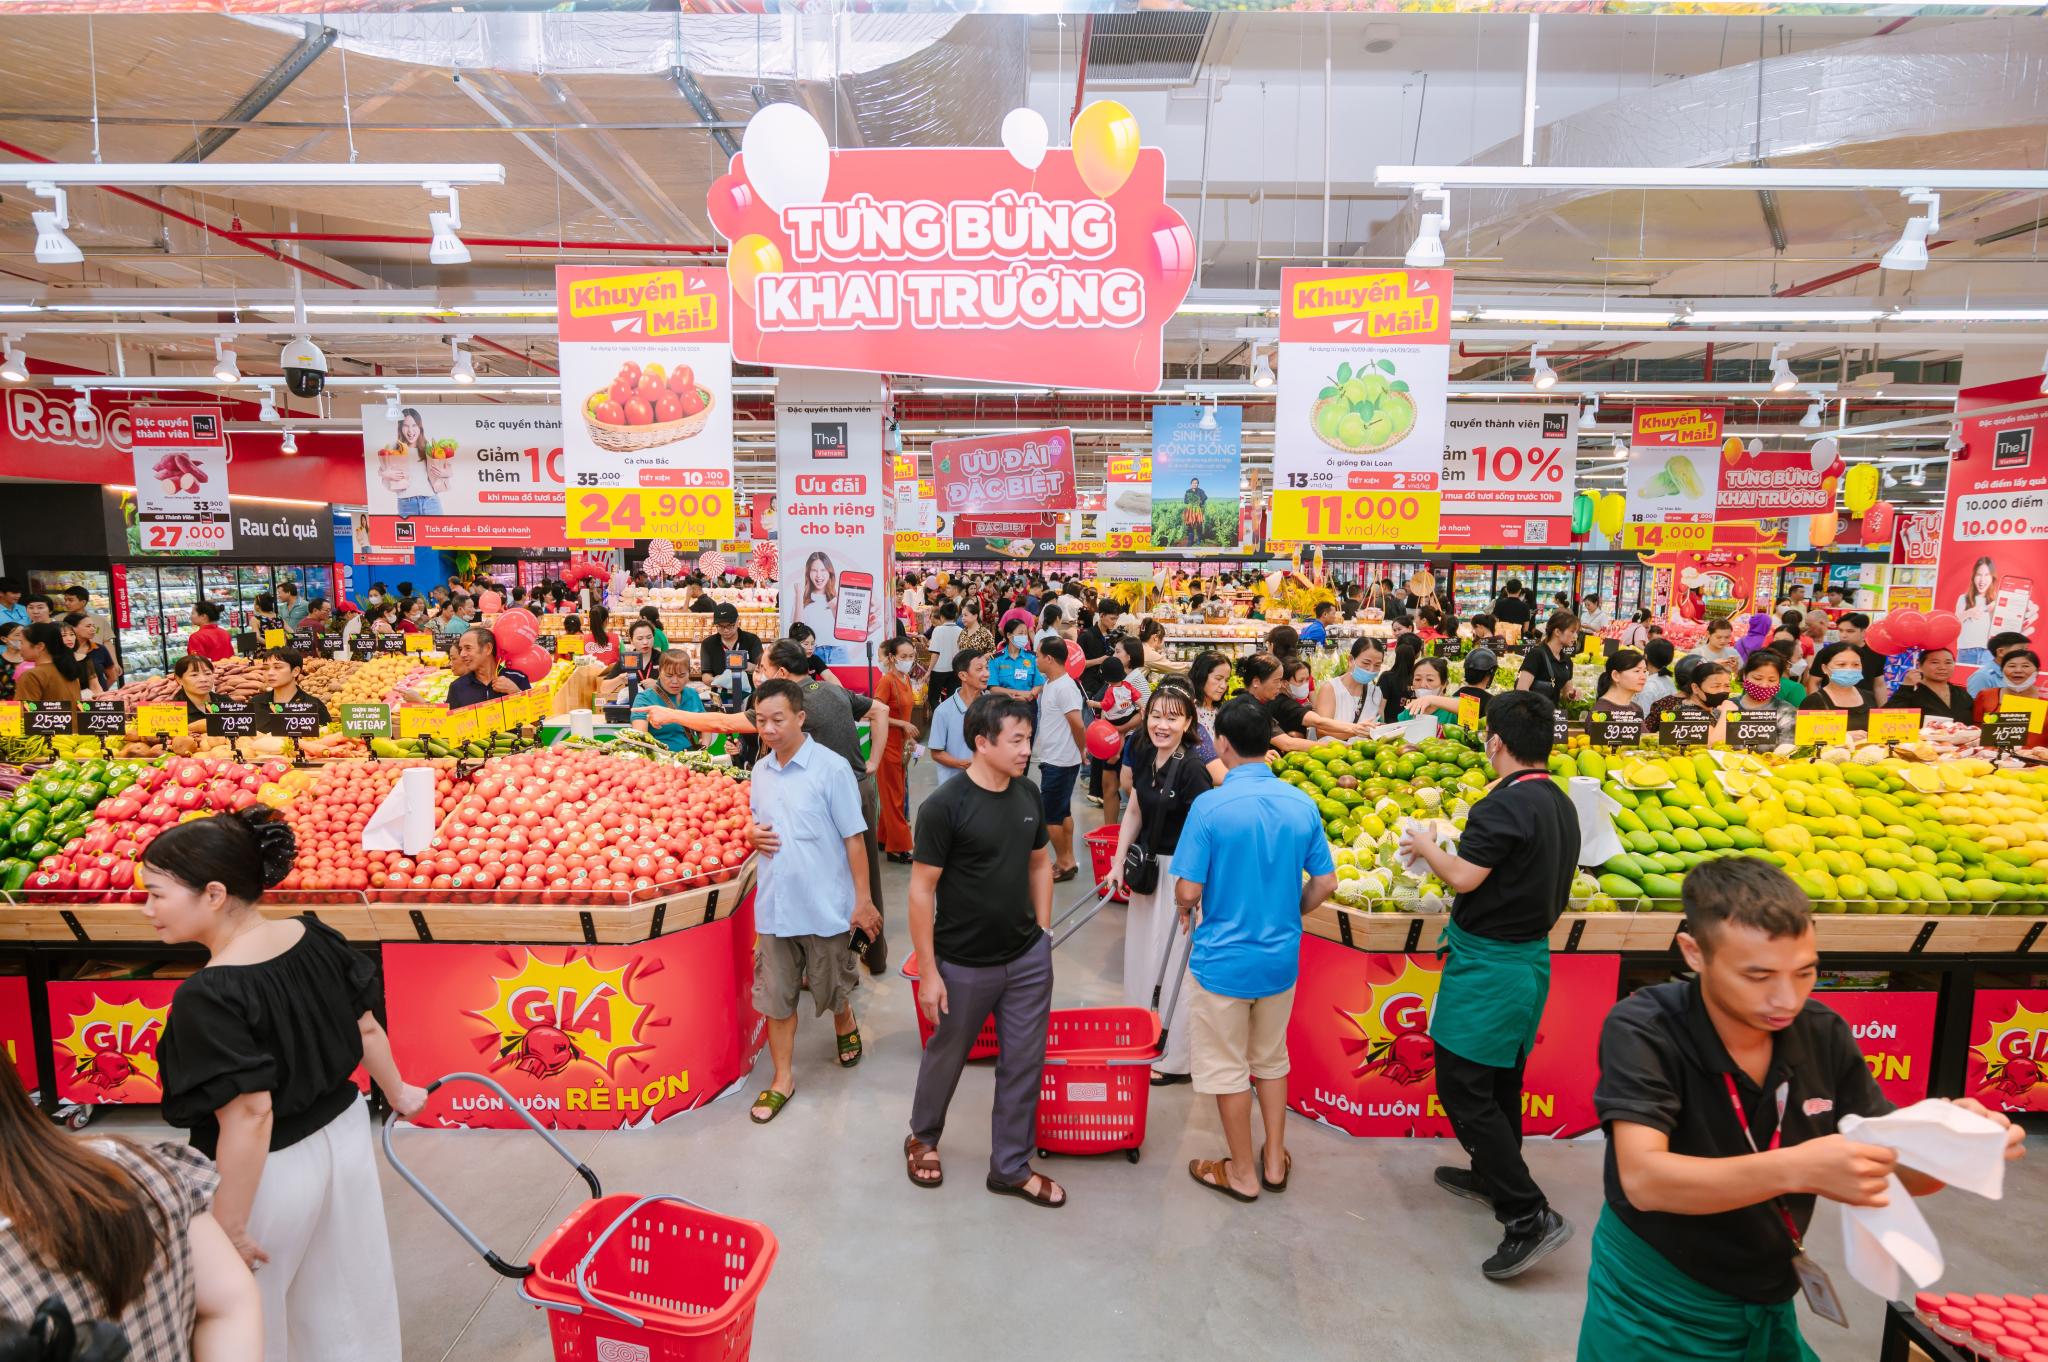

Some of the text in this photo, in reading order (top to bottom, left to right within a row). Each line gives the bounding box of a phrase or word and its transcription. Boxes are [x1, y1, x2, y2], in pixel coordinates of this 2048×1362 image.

[786, 194, 1112, 255] TƯNG BỪNG
[575, 277, 677, 309] Khuyến
[761, 268, 1141, 325] KHAI TRƯƠNG
[1298, 278, 1400, 309] Khuyến
[653, 297, 711, 333] Mãi!
[1374, 299, 1433, 335] Mãi!
[14, 393, 98, 440] Rau
[475, 419, 496, 431] Đặc
[498, 418, 531, 431] quyền
[1450, 418, 1540, 429] quyền thành viên
[1642, 413, 1697, 429] Khuyến
[136, 430, 166, 438] thành
[1681, 422, 1714, 441] Mãi!
[477, 446, 565, 483] Giảm 10
[1360, 458, 1373, 467] Đài
[1443, 445, 1564, 483] ảm 10%
[478, 467, 520, 483] thêm
[577, 473, 621, 486] 35.000
[683, 472, 723, 486] 10.100
[1287, 472, 1333, 488] 13.500
[1392, 473, 1431, 489] 2.500
[1441, 467, 1465, 481] êm
[1726, 468, 1770, 487] TƯNG
[800, 475, 860, 493] Ưu đãi
[487, 493, 500, 502] khi
[501, 494, 520, 502] mua
[522, 492, 532, 502] đồ
[553, 492, 566, 502] sốn
[1717, 488, 1827, 507] KHAI TRƯƠNG
[1965, 494, 2043, 511] 10.000 điểm
[579, 493, 722, 533] 24.900
[787, 502, 830, 517] dành
[832, 502, 875, 519] riêng
[1301, 495, 1419, 535] 11.000
[149, 526, 225, 547] 27.000
[240, 518, 269, 537] Rau
[272, 516, 290, 538] củ
[292, 518, 318, 540] quả
[425, 525, 440, 533] Tích
[508, 526, 531, 534] nhanh
[651, 521, 705, 536] vnd/kg
[800, 521, 865, 538] cho bạn
[1345, 522, 1400, 538] vnd/kg
[1634, 525, 1705, 547] 14.000
[1961, 518, 2028, 537] 10.000
[1111, 534, 1152, 549] 39.00
[346, 720, 387, 730] VIETGAP
[1603, 725, 1639, 739] 39.000
[1671, 724, 1708, 739] 45.000
[1738, 724, 1776, 739] 85.000
[508, 981, 618, 1042] GIÁ
[81, 1017, 163, 1061] GIÁ
[1852, 1020, 1897, 1039] UÔN
[1863, 1053, 1911, 1080] ƠN
[452, 1069, 690, 1112] LUÔN UÔN RẺ HƠN
[1314, 1087, 1420, 1117] LUÔN LUÔN
